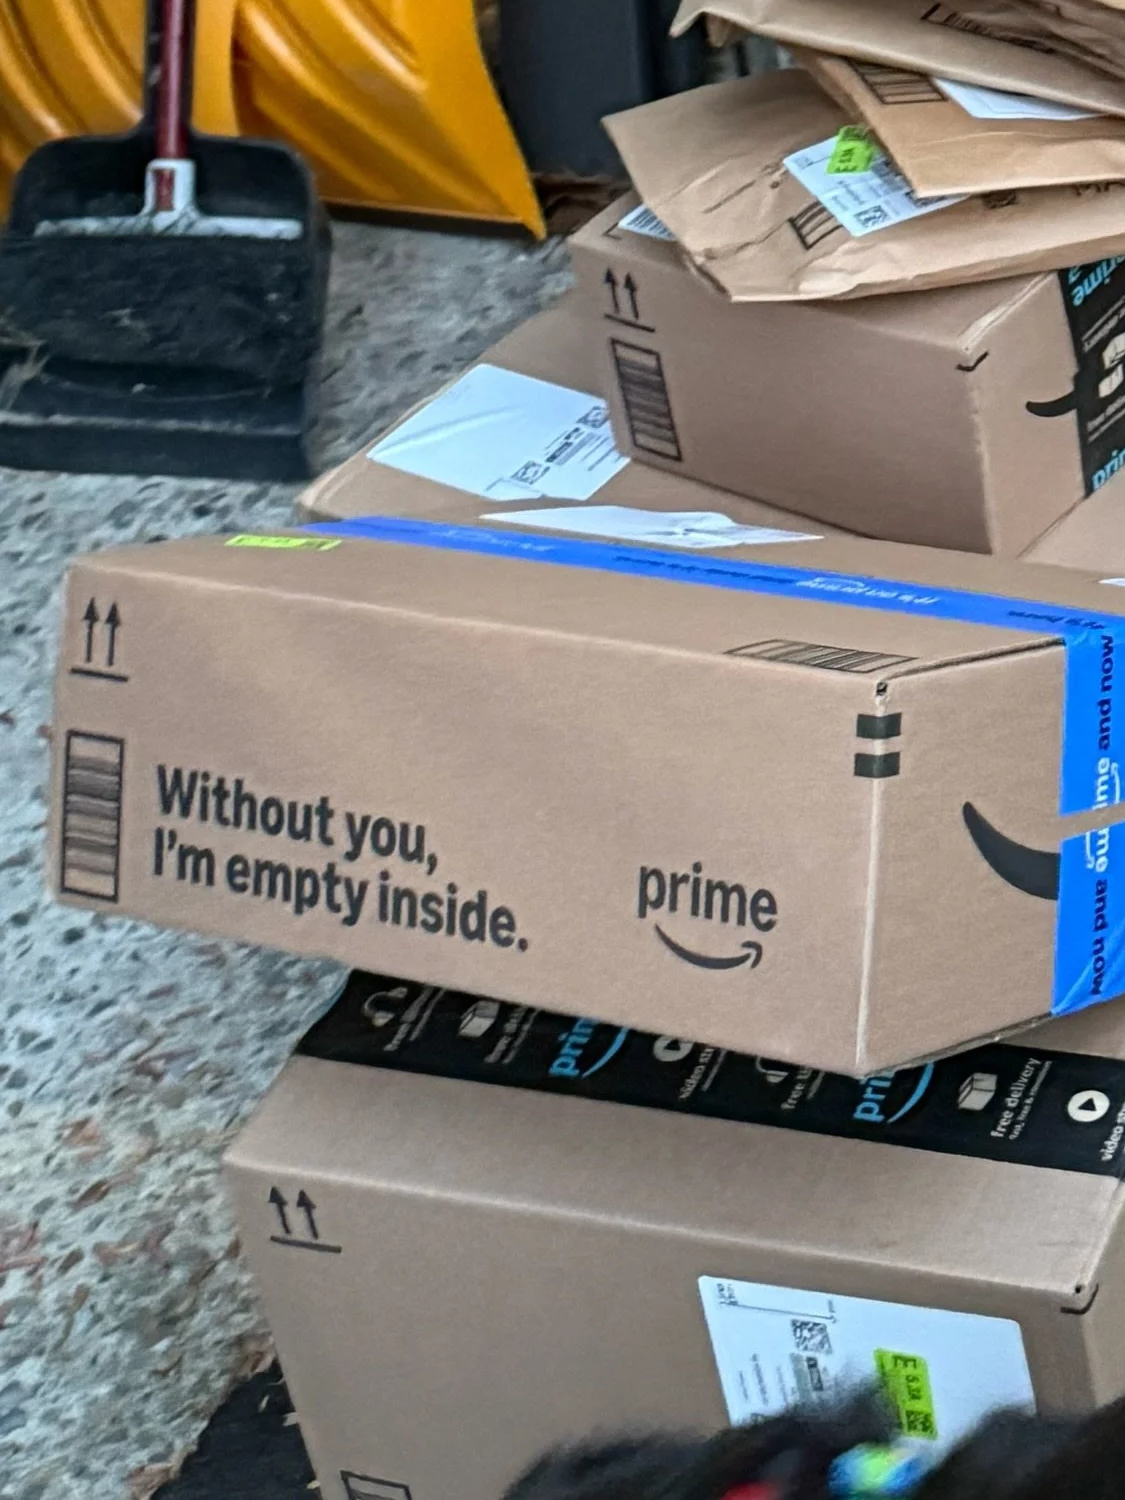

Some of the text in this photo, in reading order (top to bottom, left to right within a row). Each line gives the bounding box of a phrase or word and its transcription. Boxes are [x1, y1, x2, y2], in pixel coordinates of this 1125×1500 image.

[1100, 634, 1115, 693] now
[1097, 697, 1113, 751] and
[156, 764, 438, 876] Without you,
[153, 826, 529, 953] I'm empty inside.
[637, 860, 778, 933] prime
[1094, 879, 1108, 933] and
[990, 1110, 1016, 1138] free
[1004, 1057, 1042, 1109] delivery
[1099, 1125, 1125, 1161] video
[892, 1354, 918, 1370] E
